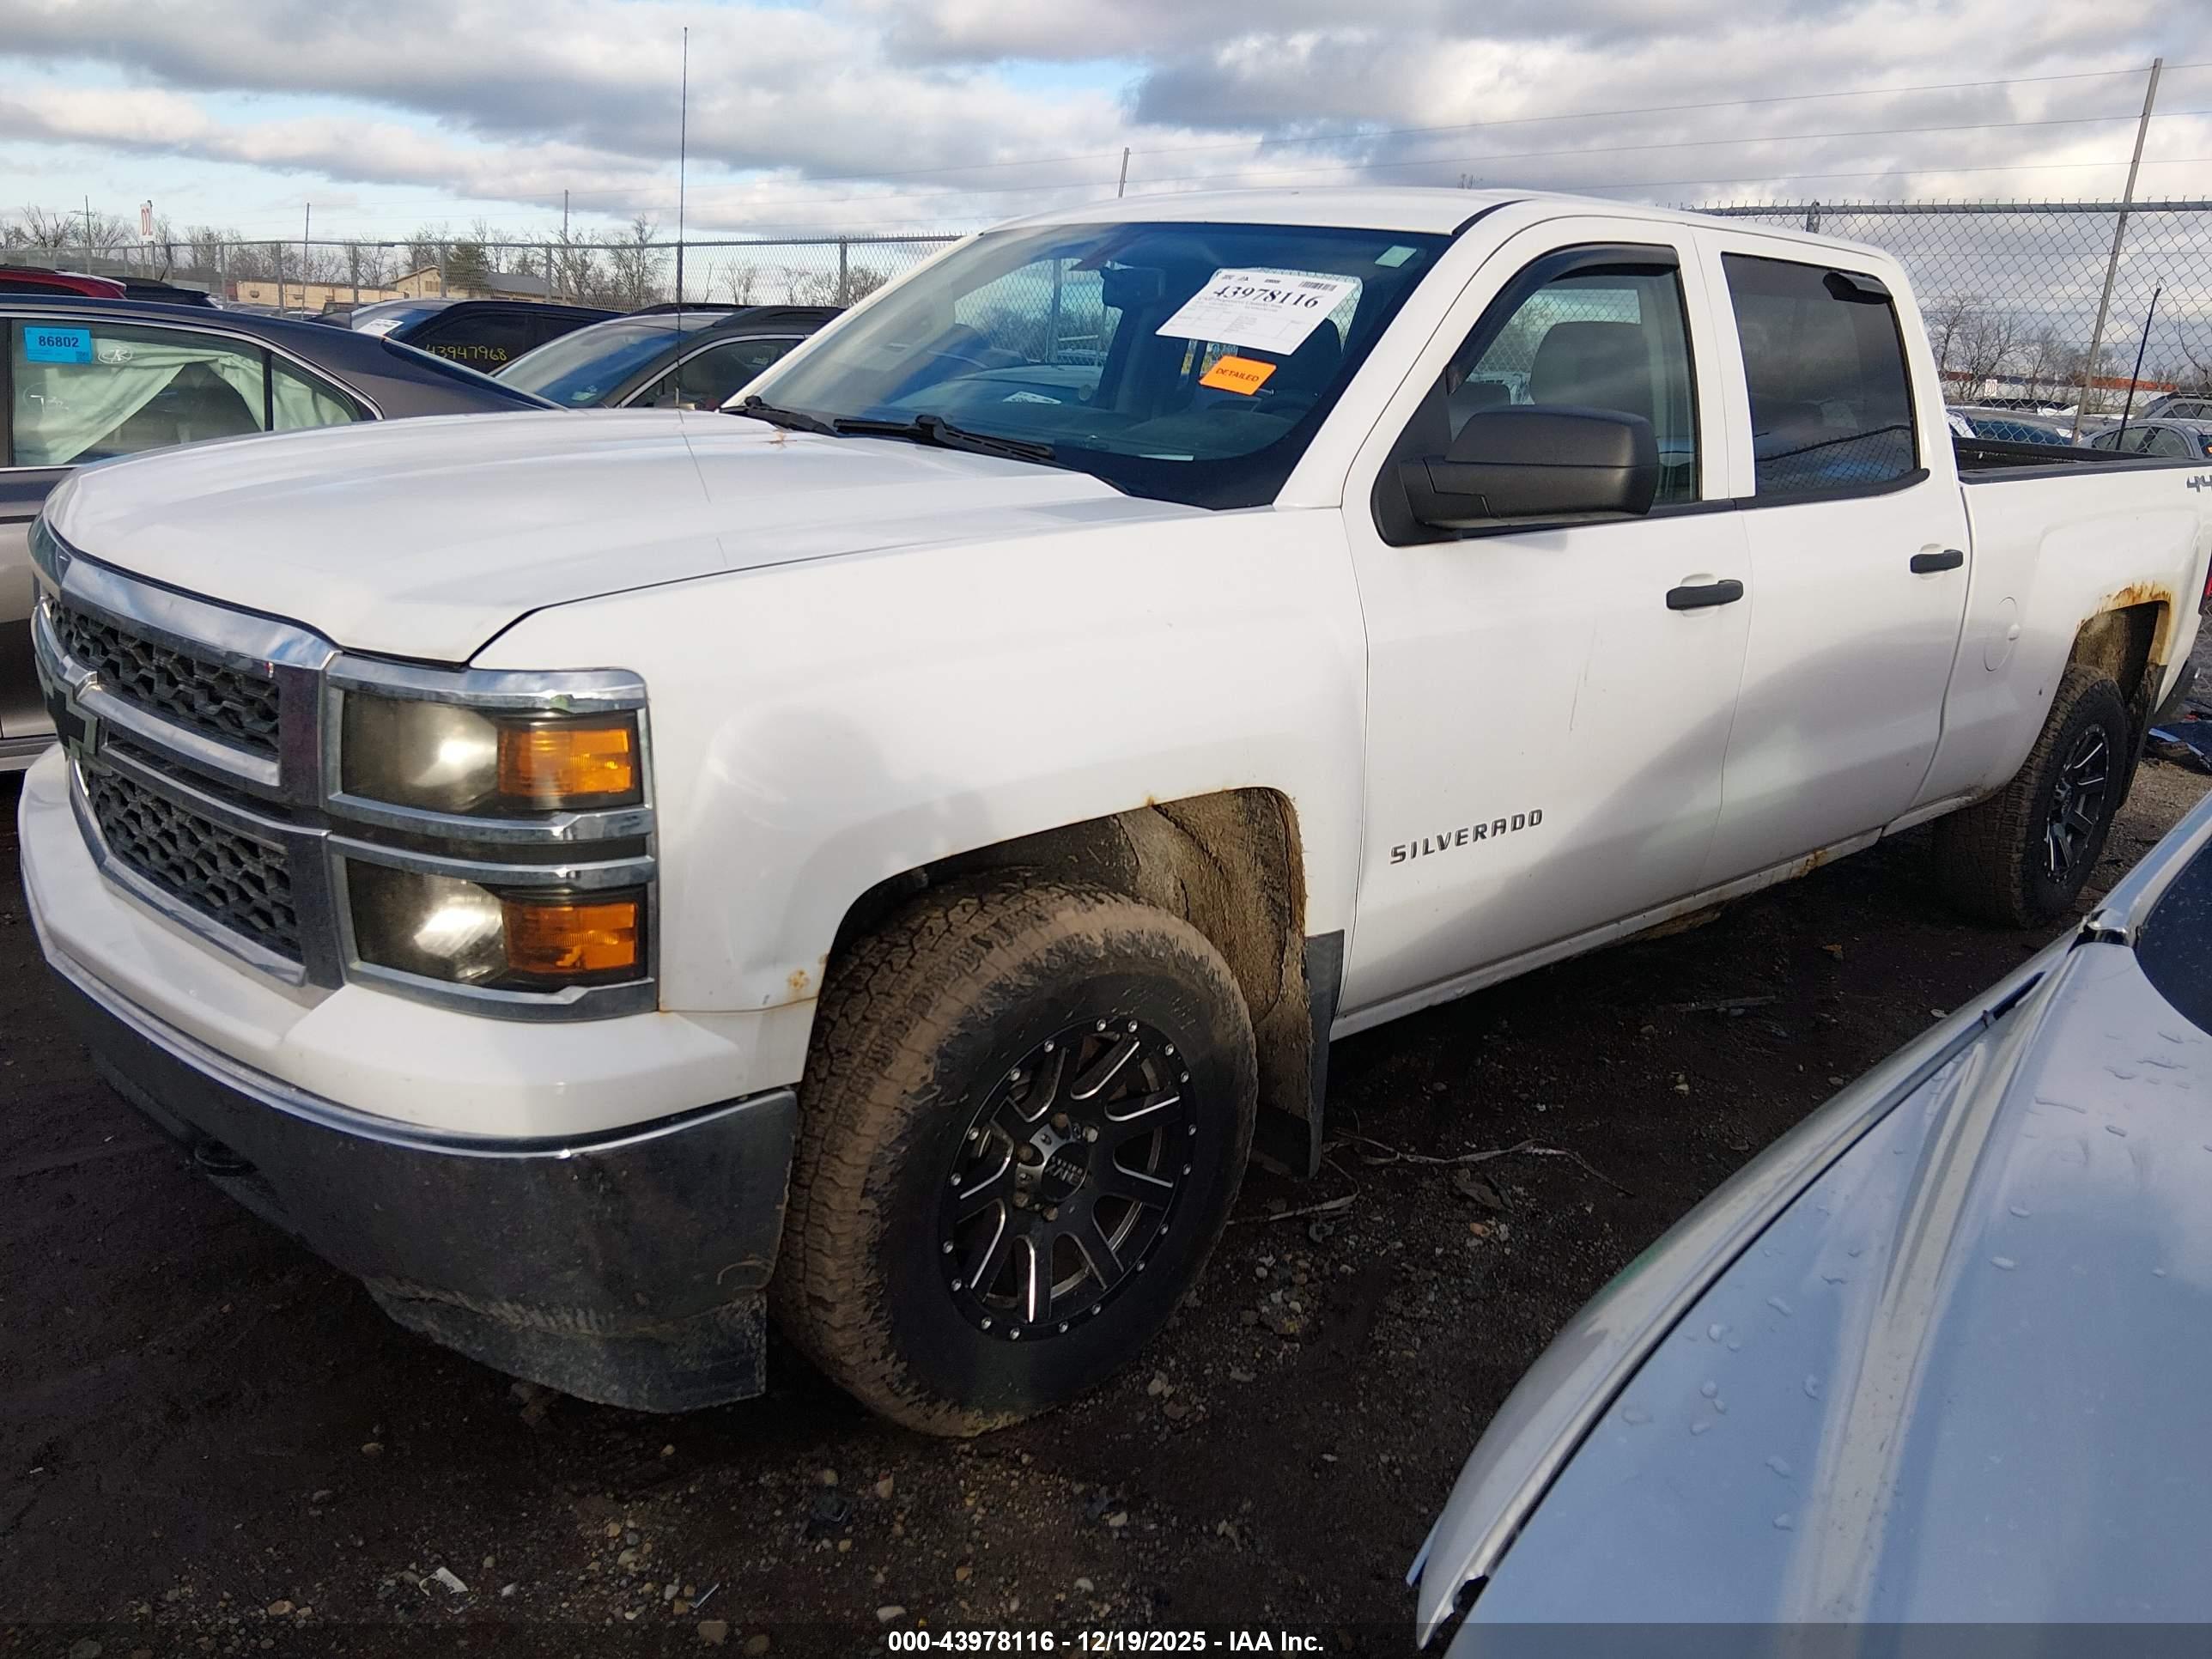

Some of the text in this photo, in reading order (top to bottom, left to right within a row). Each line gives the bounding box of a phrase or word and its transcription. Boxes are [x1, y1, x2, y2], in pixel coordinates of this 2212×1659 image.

[1213, 285, 1322, 308] 43978116
[39, 336, 79, 348] 86802
[426, 345, 507, 361] 43947968
[1216, 368, 1260, 382] DETAILED
[1390, 809, 1543, 864] SILVERADO
